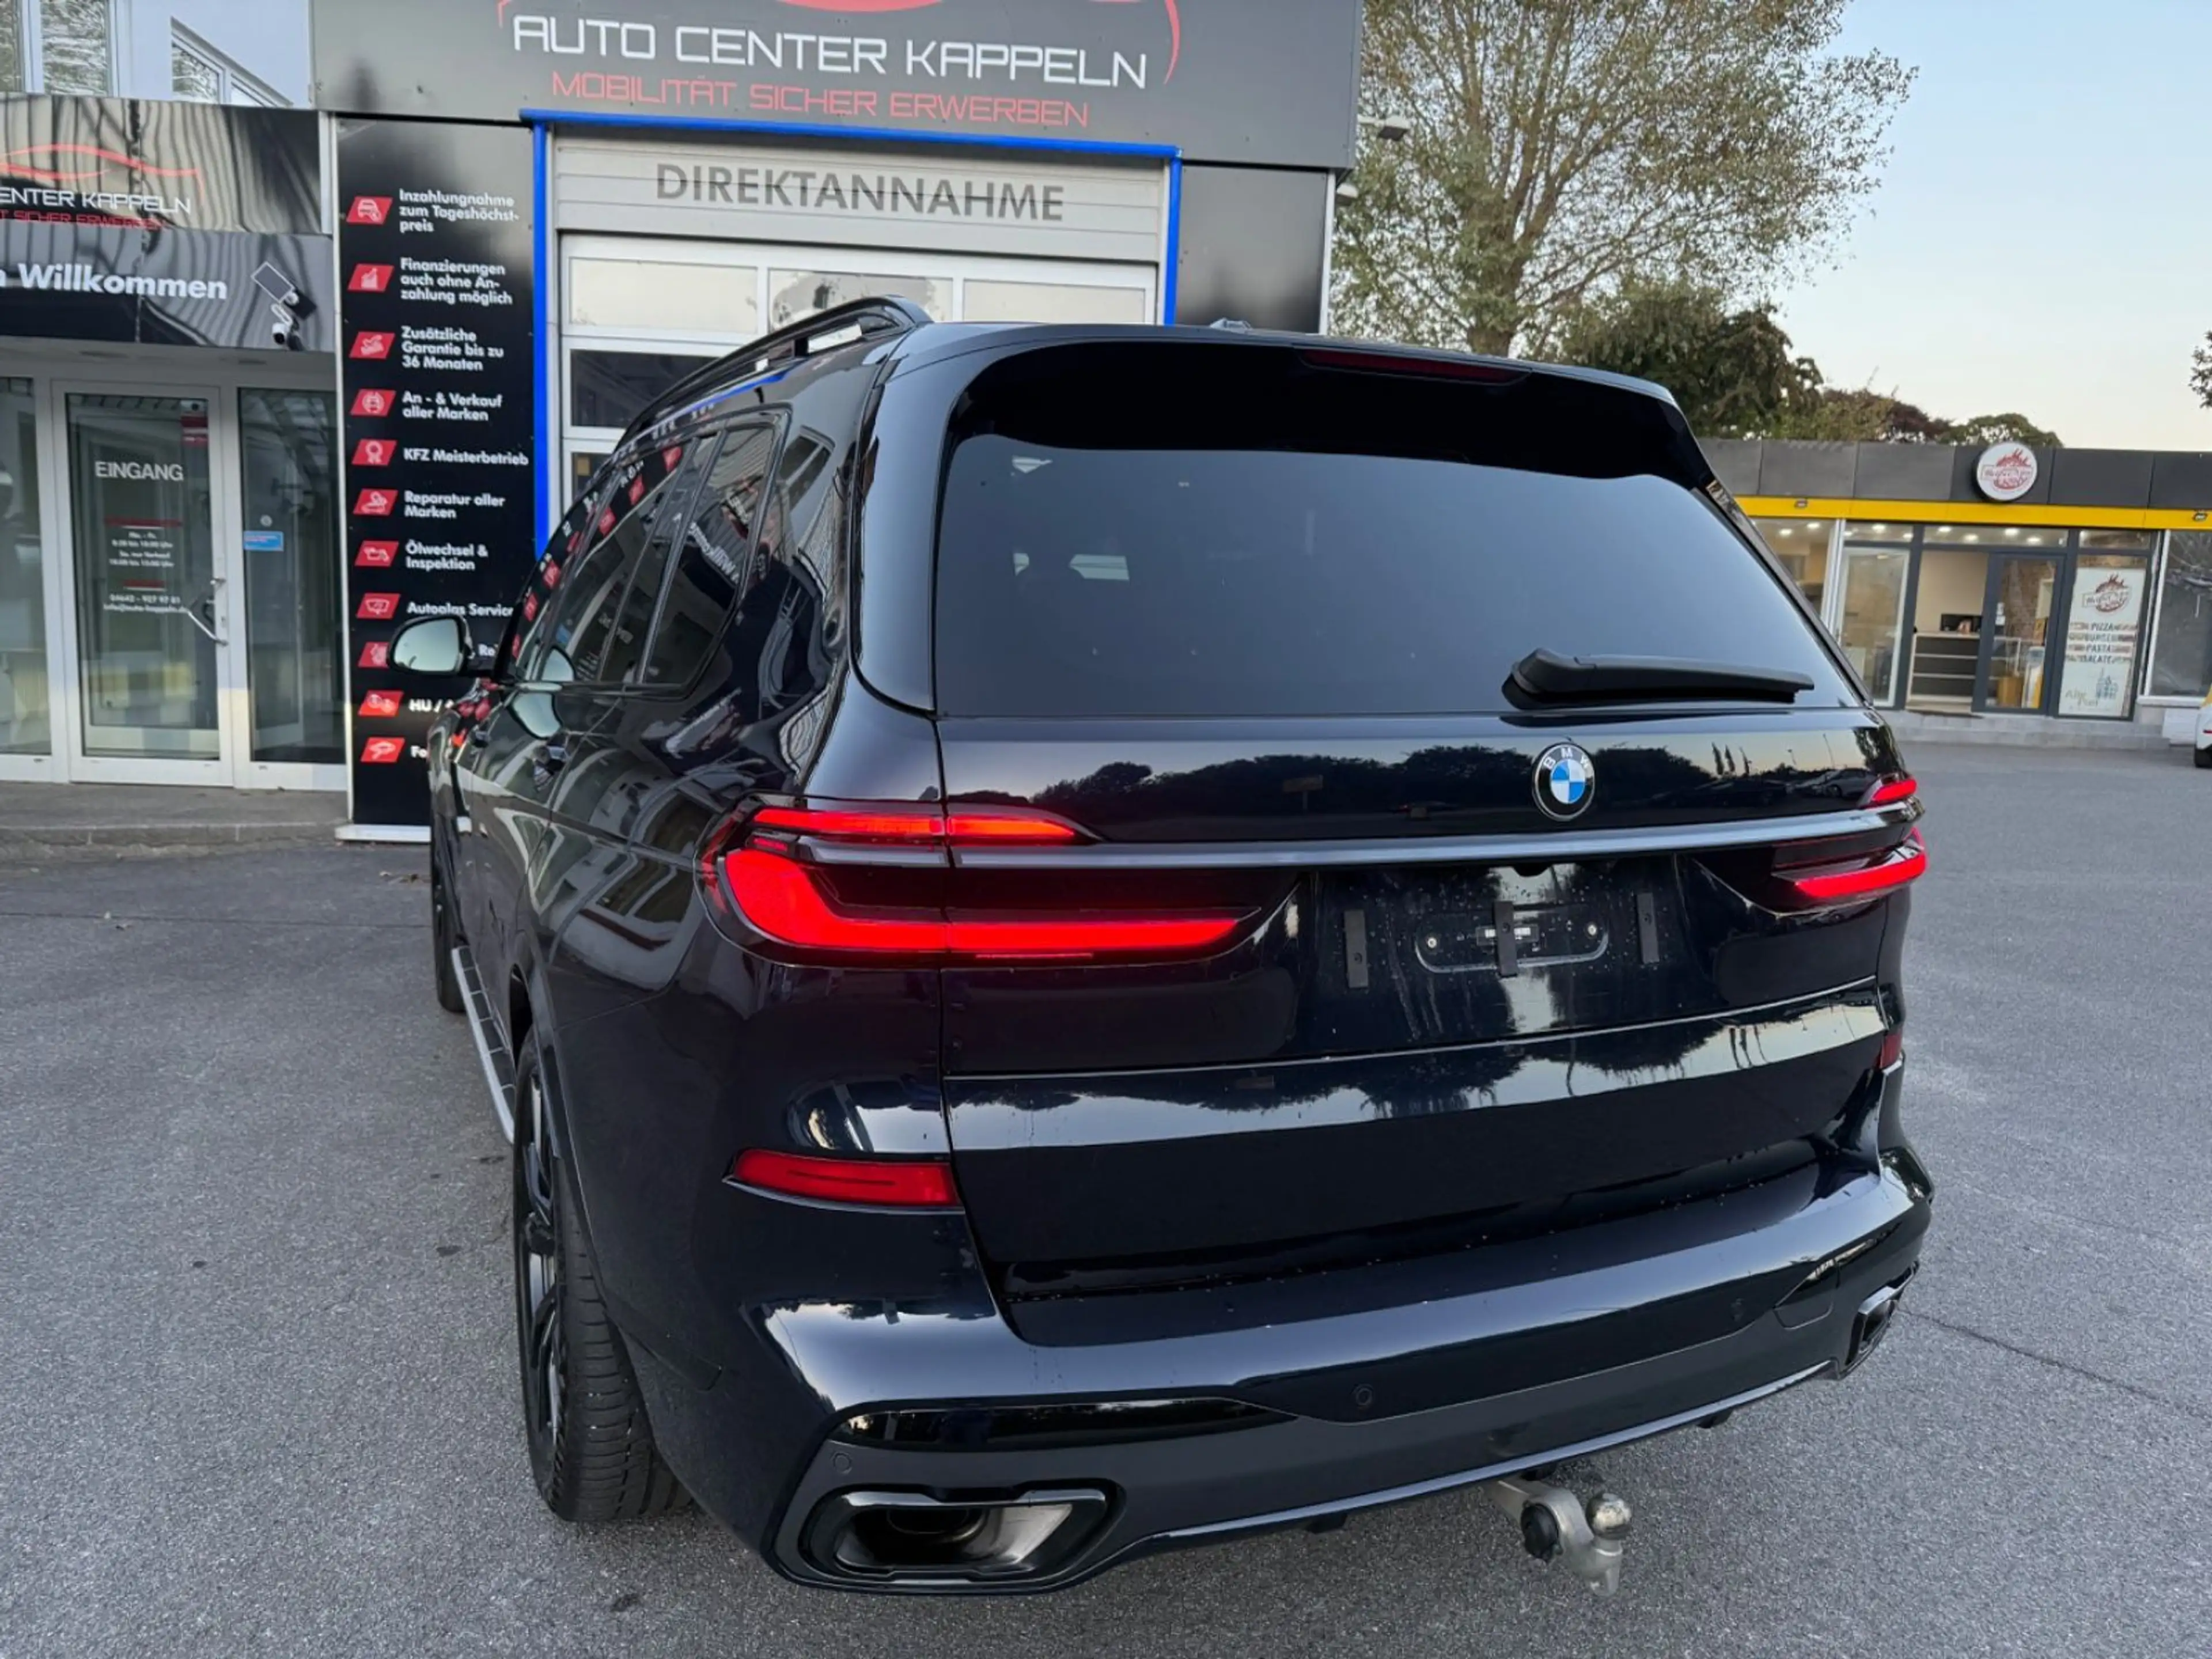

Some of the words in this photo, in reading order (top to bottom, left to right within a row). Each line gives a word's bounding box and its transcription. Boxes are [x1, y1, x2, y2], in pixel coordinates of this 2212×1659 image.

[513, 15, 656, 59] AUTO
[676, 26, 887, 74] CENTER
[906, 39, 1146, 89] KAPPELN
[552, 71, 737, 107] MOBILITÄT
[750, 84, 877, 117] SICHER
[889, 92, 1089, 127] ERWERBEN
[399, 188, 515, 207] Inzahlungnahme
[657, 163, 1065, 222] DIREKTANNAHME
[82, 191, 191, 214] KAPPELN
[399, 206, 429, 217] zum
[400, 218, 434, 233] preis
[400, 257, 505, 276] Finanzierungen
[18, 263, 227, 299] Willkommen
[400, 273, 434, 286] auch
[437, 274, 472, 287] ohne
[475, 276, 500, 289] An-
[401, 287, 456, 305] zahlung
[459, 290, 513, 306] möglich
[402, 325, 477, 342] Zusätzliche
[402, 341, 461, 355] Garantie
[464, 343, 485, 357] bis
[487, 347, 504, 358] zu
[402, 355, 421, 368] 36
[423, 355, 483, 371] Monaten
[435, 392, 446, 404] &
[448, 392, 502, 408] Verkauf
[403, 405, 434, 418] aller
[437, 406, 488, 421] Marken
[404, 448, 430, 461] KFZ
[433, 449, 529, 465] Meisterbetrieb
[95, 461, 184, 481] EINGANG
[404, 490, 472, 506] Reparatur
[474, 493, 506, 507] aller
[404, 505, 457, 518] Marken
[405, 539, 474, 556] Ölwechsel
[477, 544, 488, 557] &
[406, 555, 475, 572] Inspektion
[408, 698, 432, 712] HU
[1543, 748, 1590, 770] BMW
